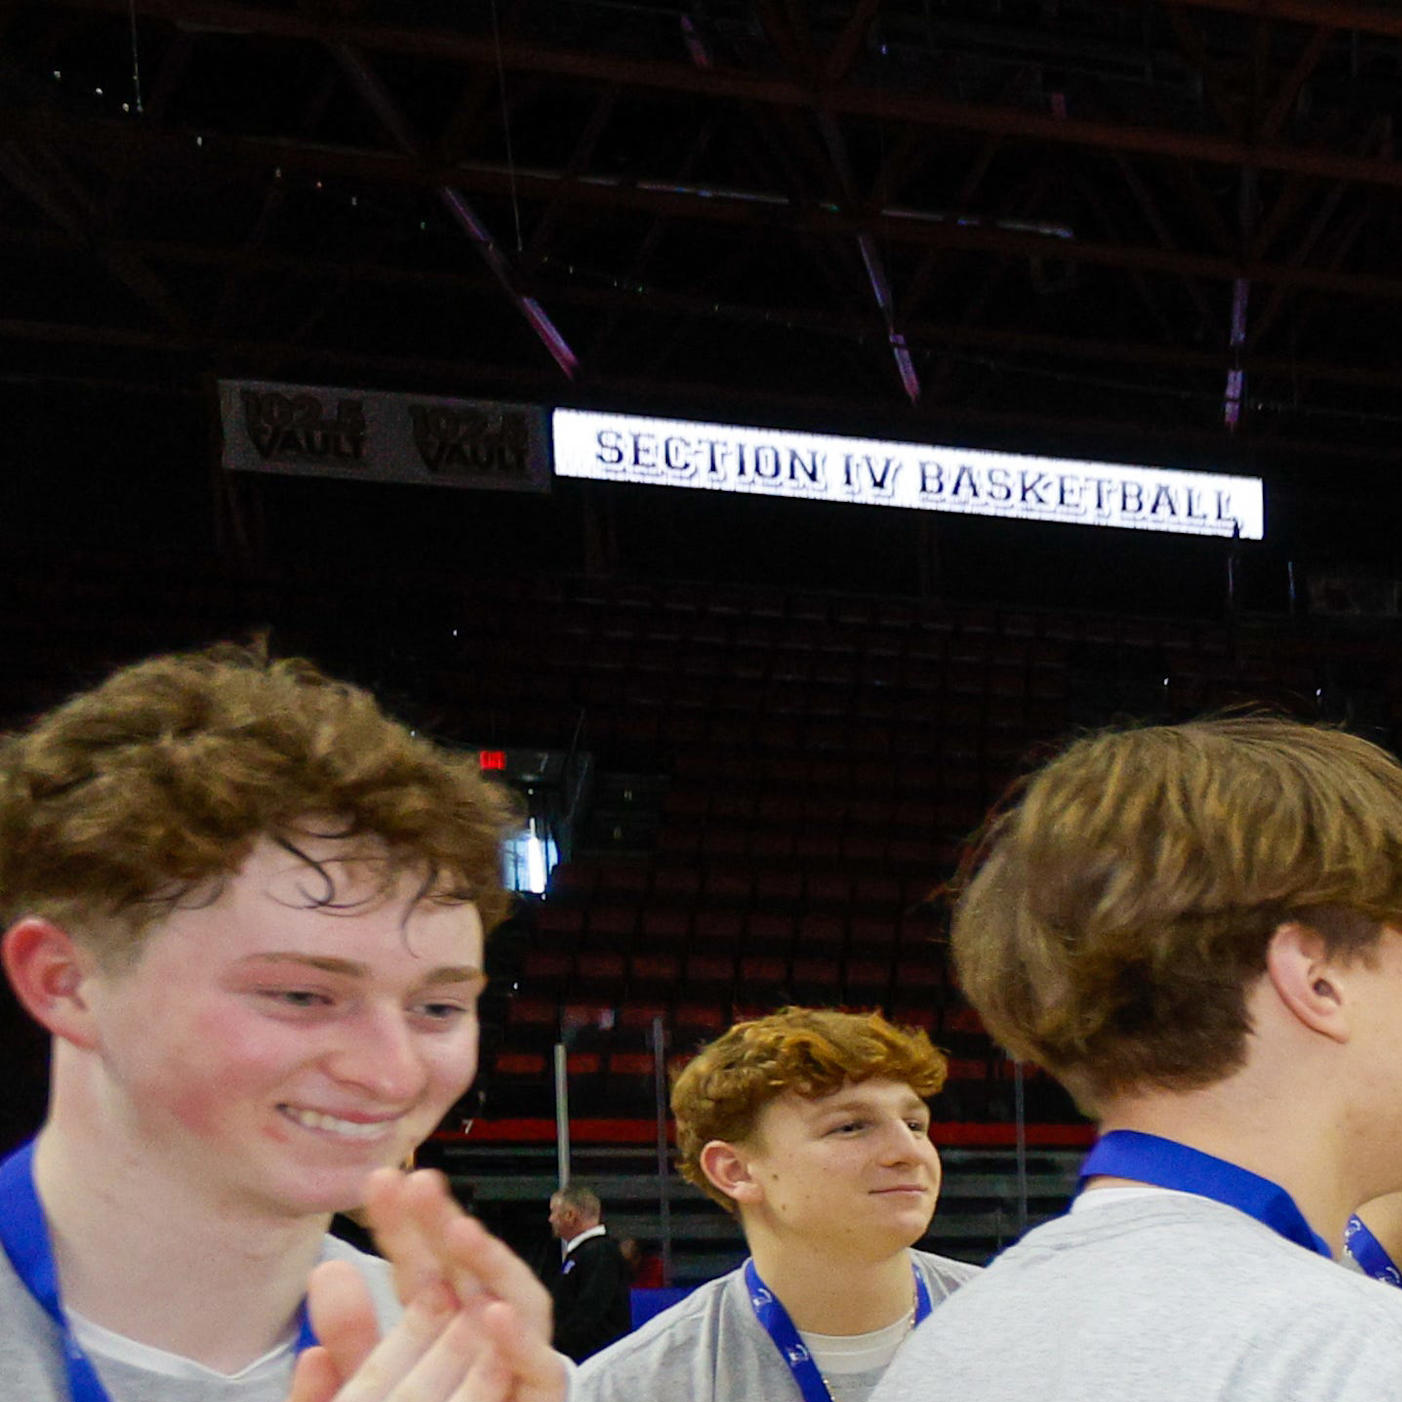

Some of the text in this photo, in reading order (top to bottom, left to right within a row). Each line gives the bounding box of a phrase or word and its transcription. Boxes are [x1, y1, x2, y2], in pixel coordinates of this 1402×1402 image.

[595, 430, 1240, 526] SECTION IV BASKETBALL
